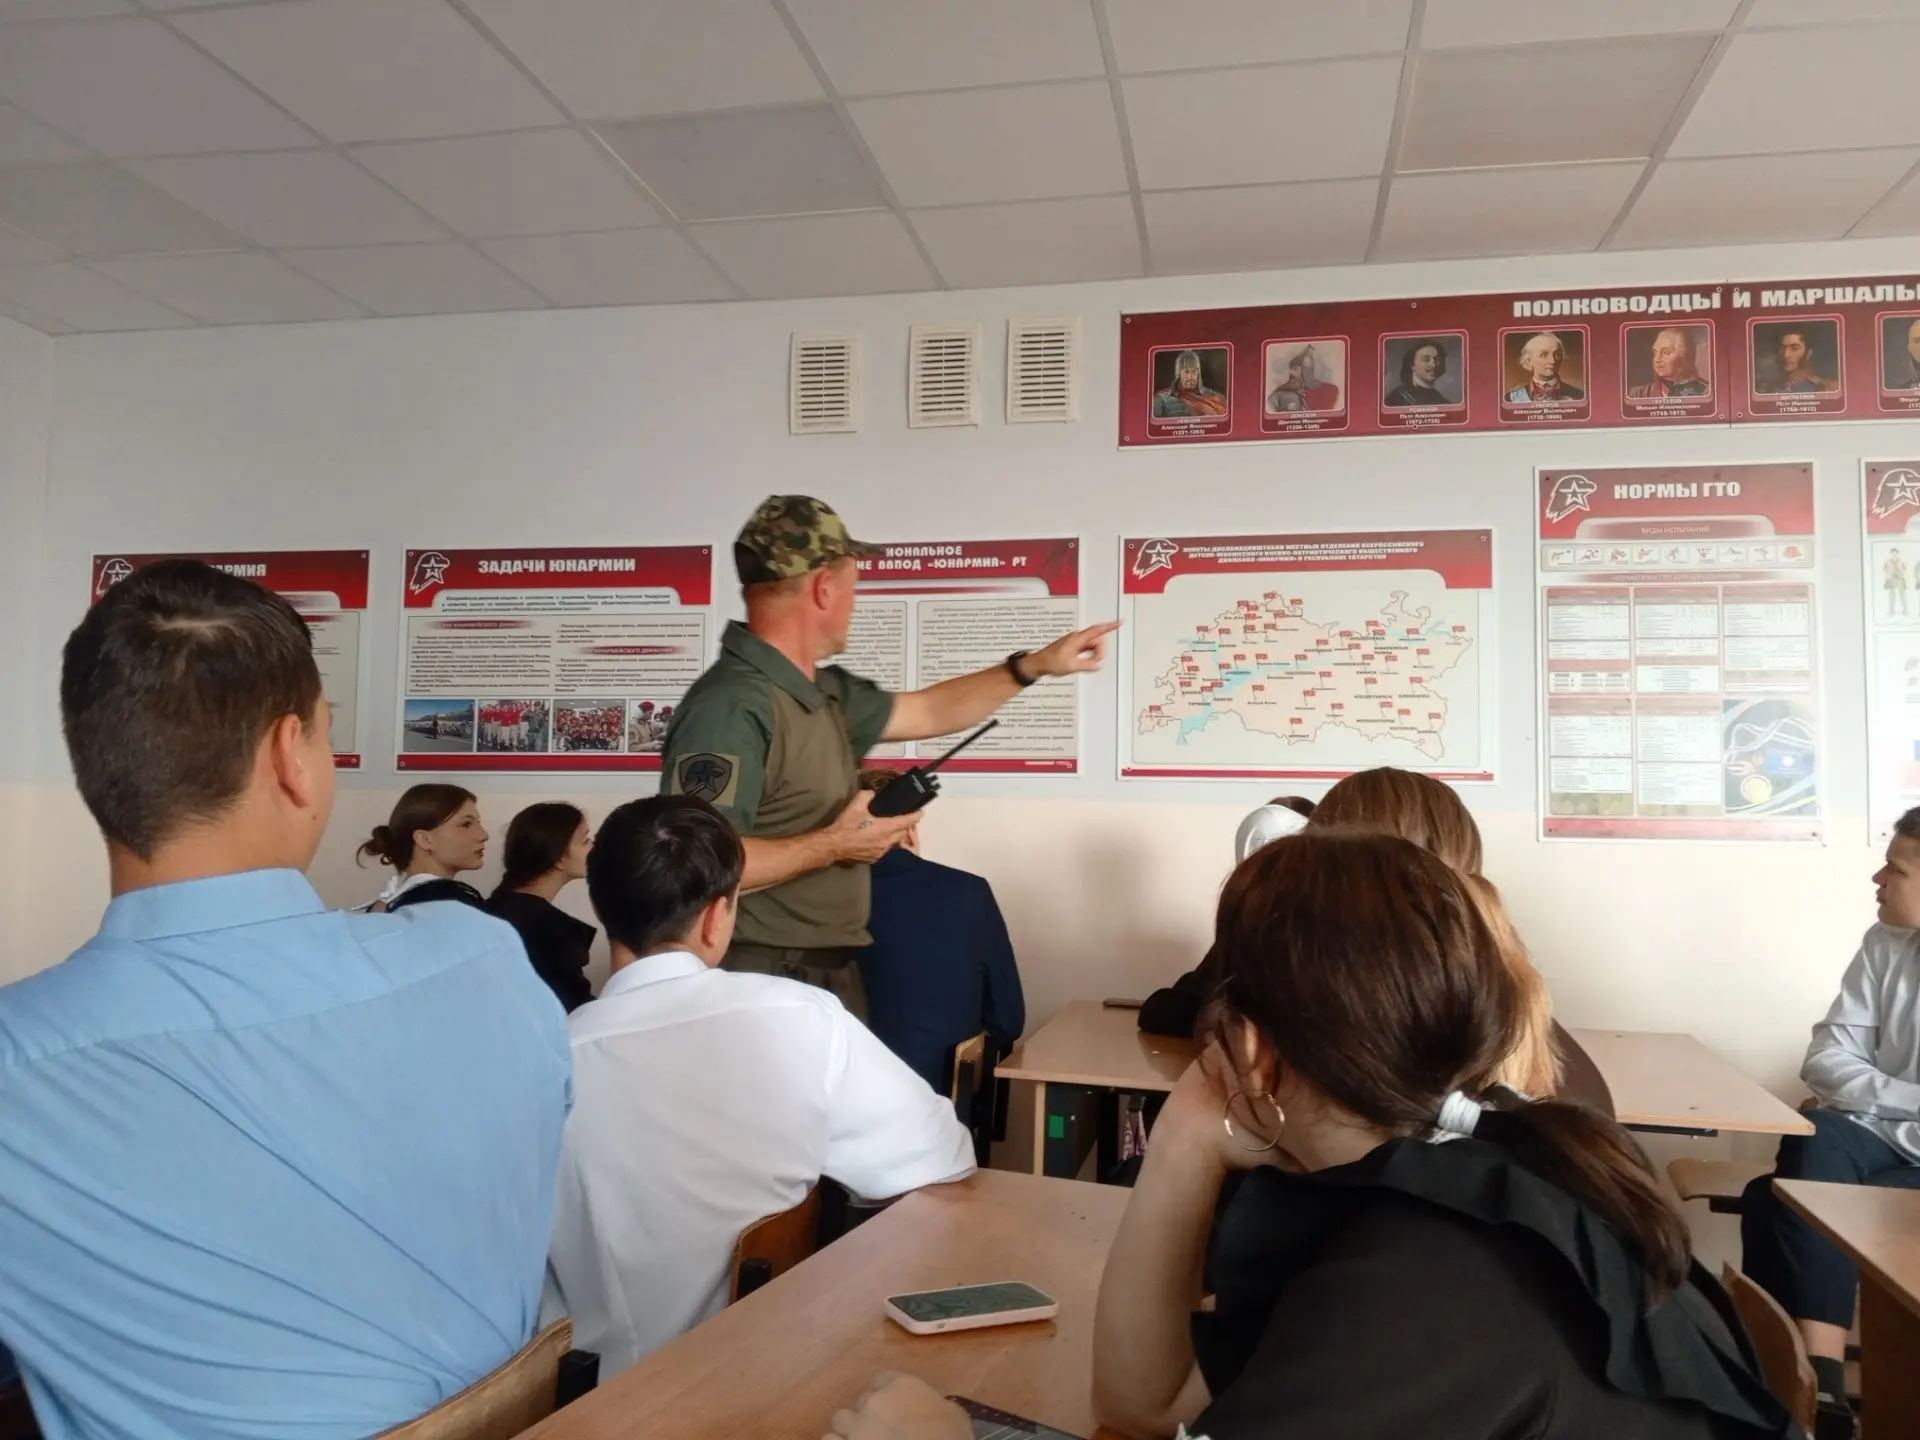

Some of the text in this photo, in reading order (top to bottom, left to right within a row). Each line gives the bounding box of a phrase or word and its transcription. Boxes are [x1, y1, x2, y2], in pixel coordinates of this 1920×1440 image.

[1513, 292, 1720, 318] ПОЛКОВОДЦЫ
[1733, 290, 1750, 309] И
[1614, 481, 1741, 500] НОРМЫ ГТО
[885, 545, 962, 557] ИОНАЛЬНОЕ
[478, 558, 636, 575] ЗАДАЧИ ЮНАРМИИ
[928, 557, 1006, 569] «ЮНАРМИЯ»
[1012, 556, 1027, 567] РТ
[208, 564, 267, 577] РМИЯ
